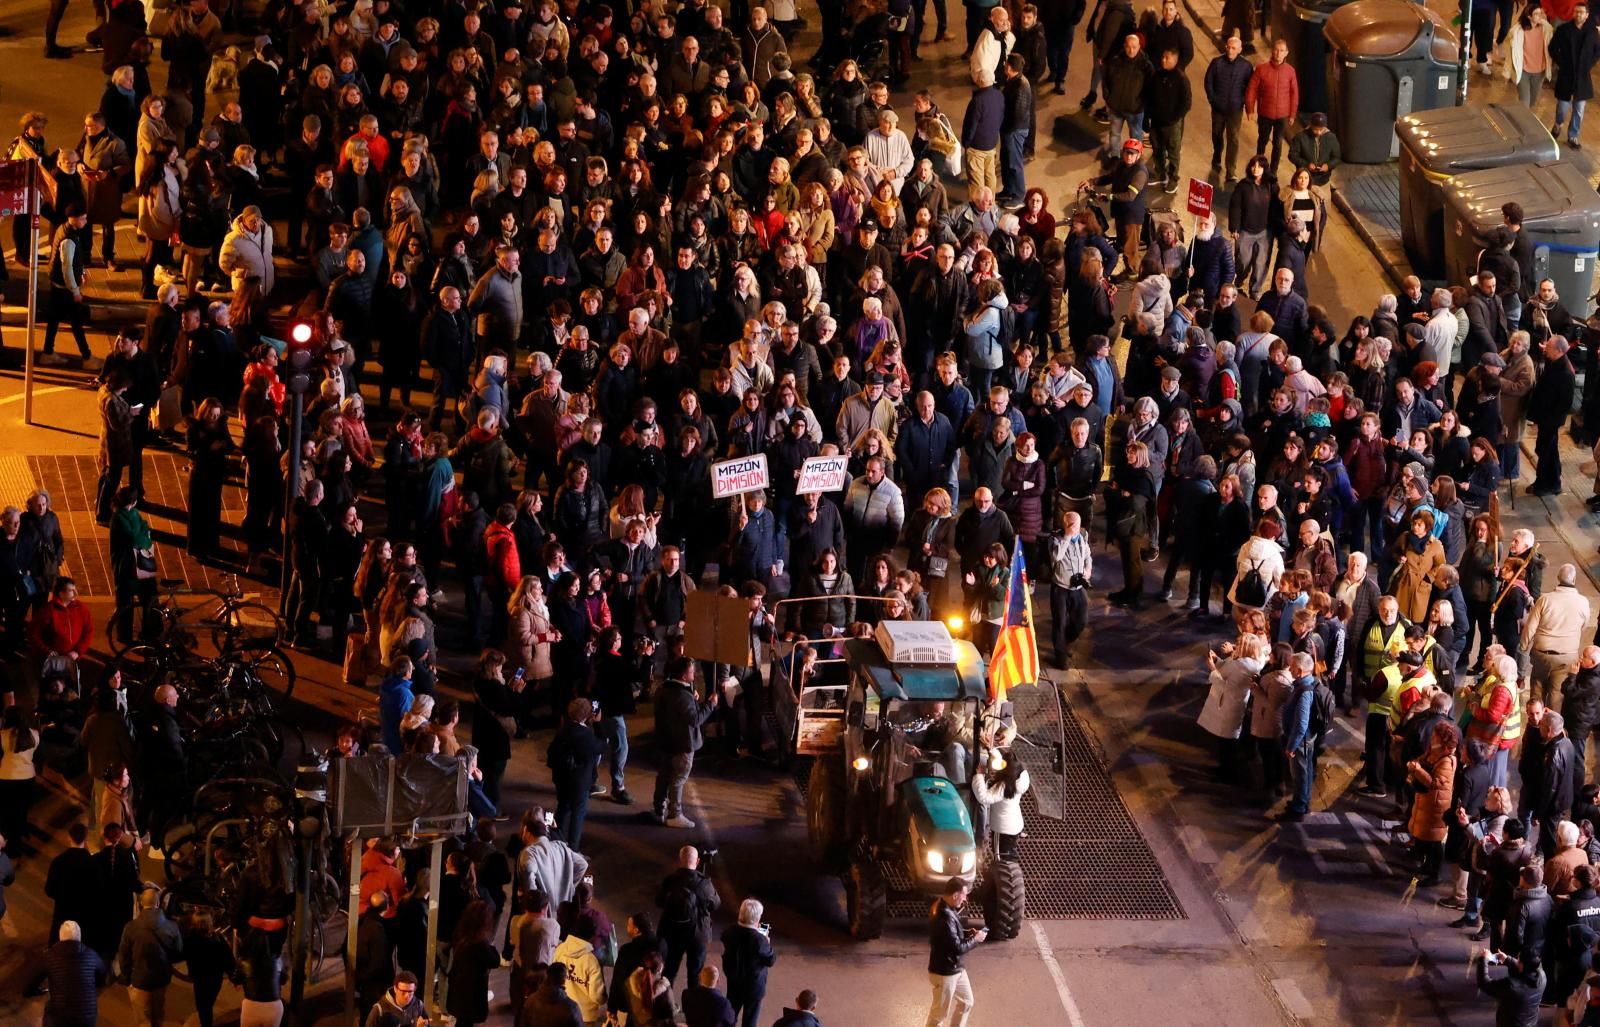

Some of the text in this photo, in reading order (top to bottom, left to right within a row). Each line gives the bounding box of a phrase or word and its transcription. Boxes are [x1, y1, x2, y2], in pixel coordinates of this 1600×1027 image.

[718, 459, 760, 477] MAZÓN
[806, 459, 843, 473] MAZÓN
[801, 471, 842, 489] DIMISIÓN
[1577, 906, 1600, 917] umbr
